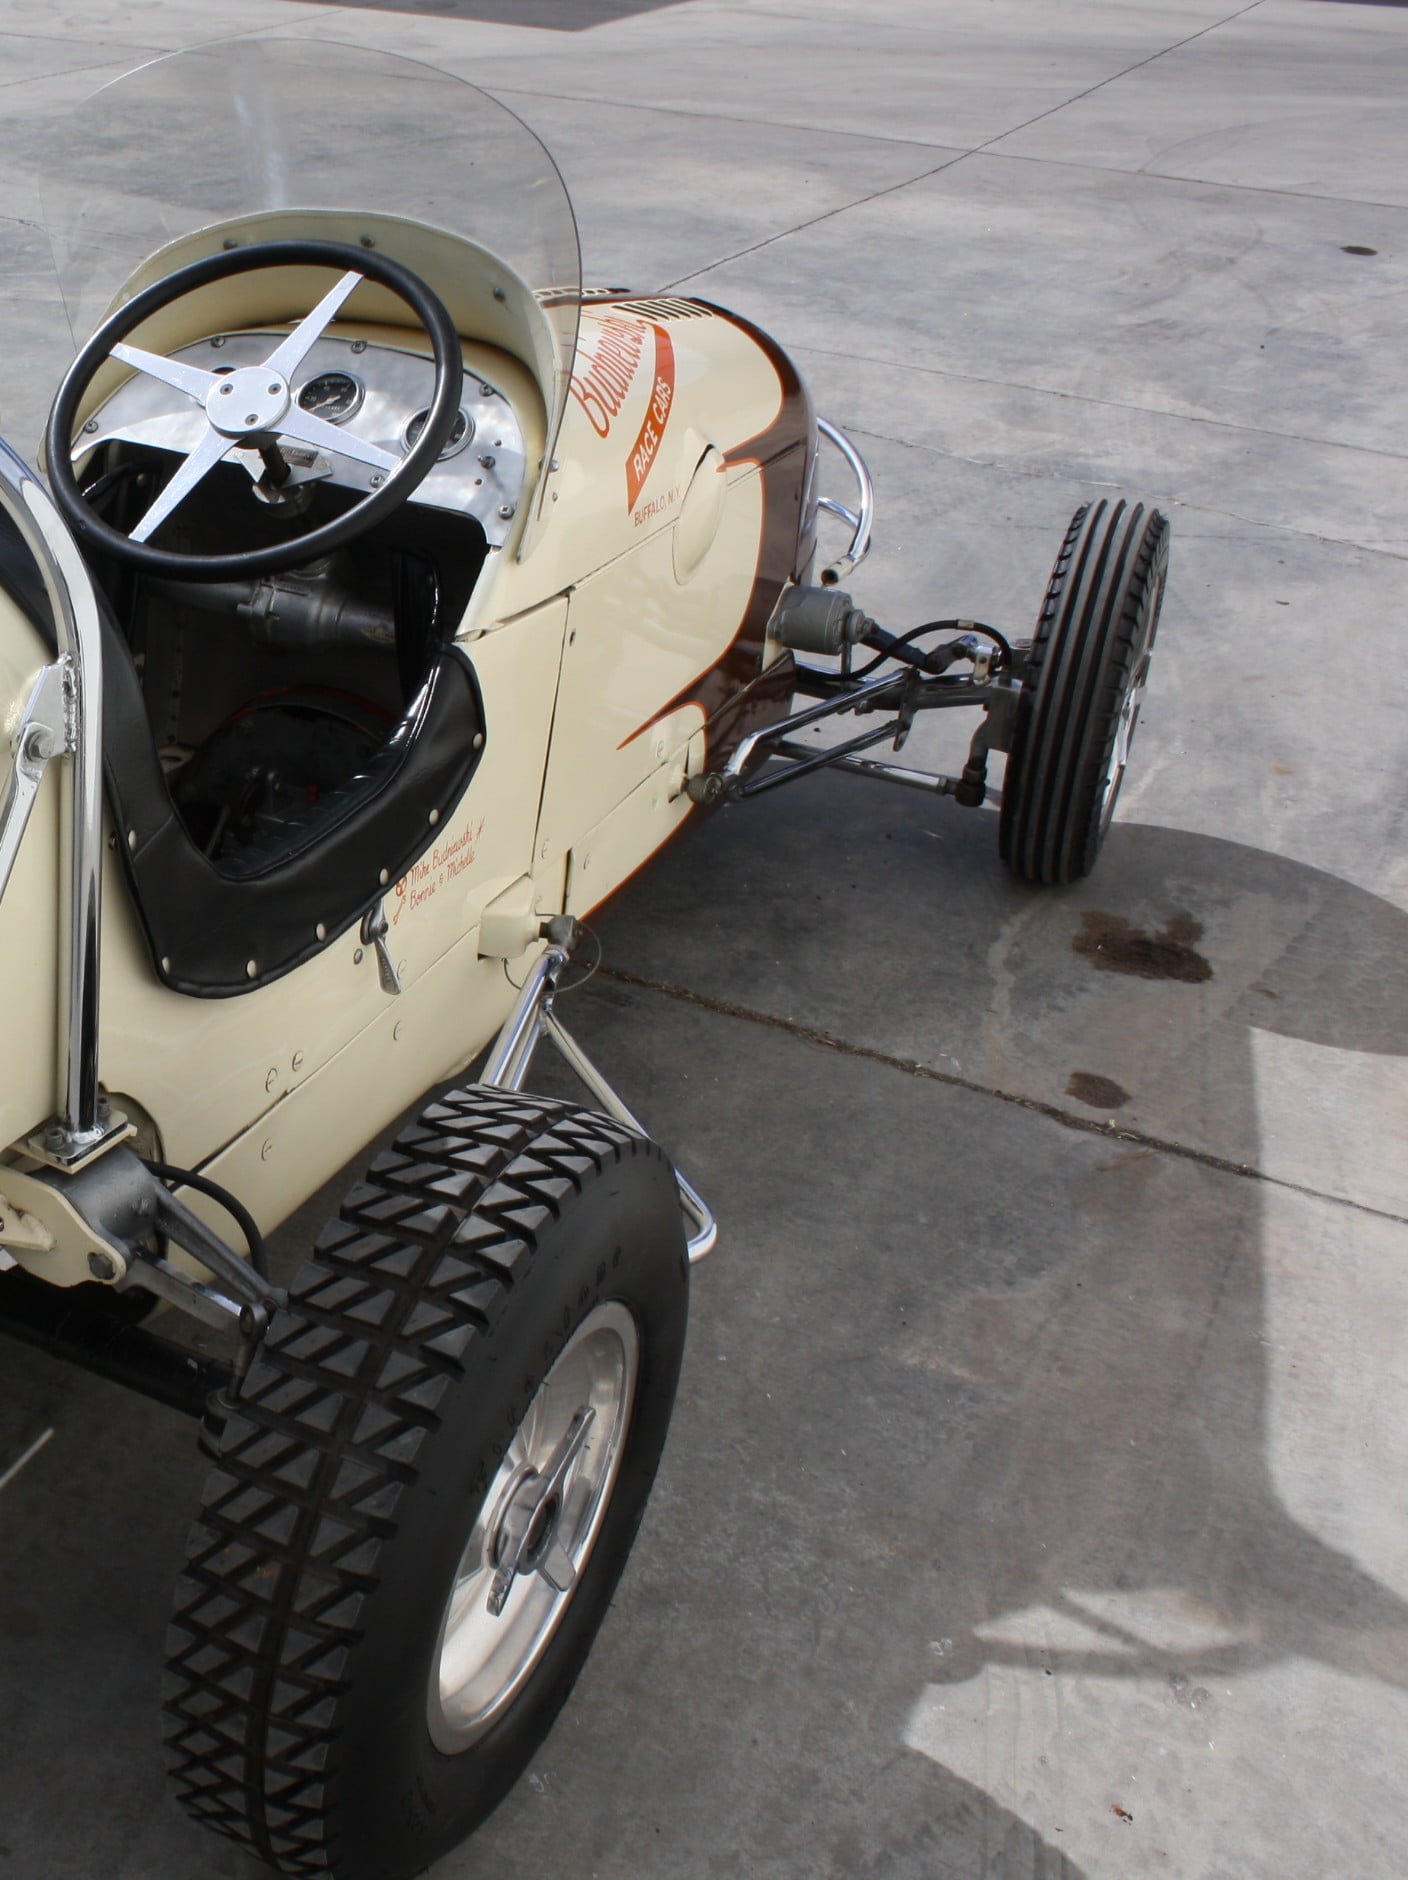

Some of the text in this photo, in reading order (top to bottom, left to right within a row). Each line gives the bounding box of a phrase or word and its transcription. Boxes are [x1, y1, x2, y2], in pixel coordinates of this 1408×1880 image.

[634, 377, 672, 482] RACE CARS
[634, 487, 681, 528] BUFFALO, N.Y.
[410, 861, 430, 887] Mike
[410, 876, 437, 911] Bonnie
